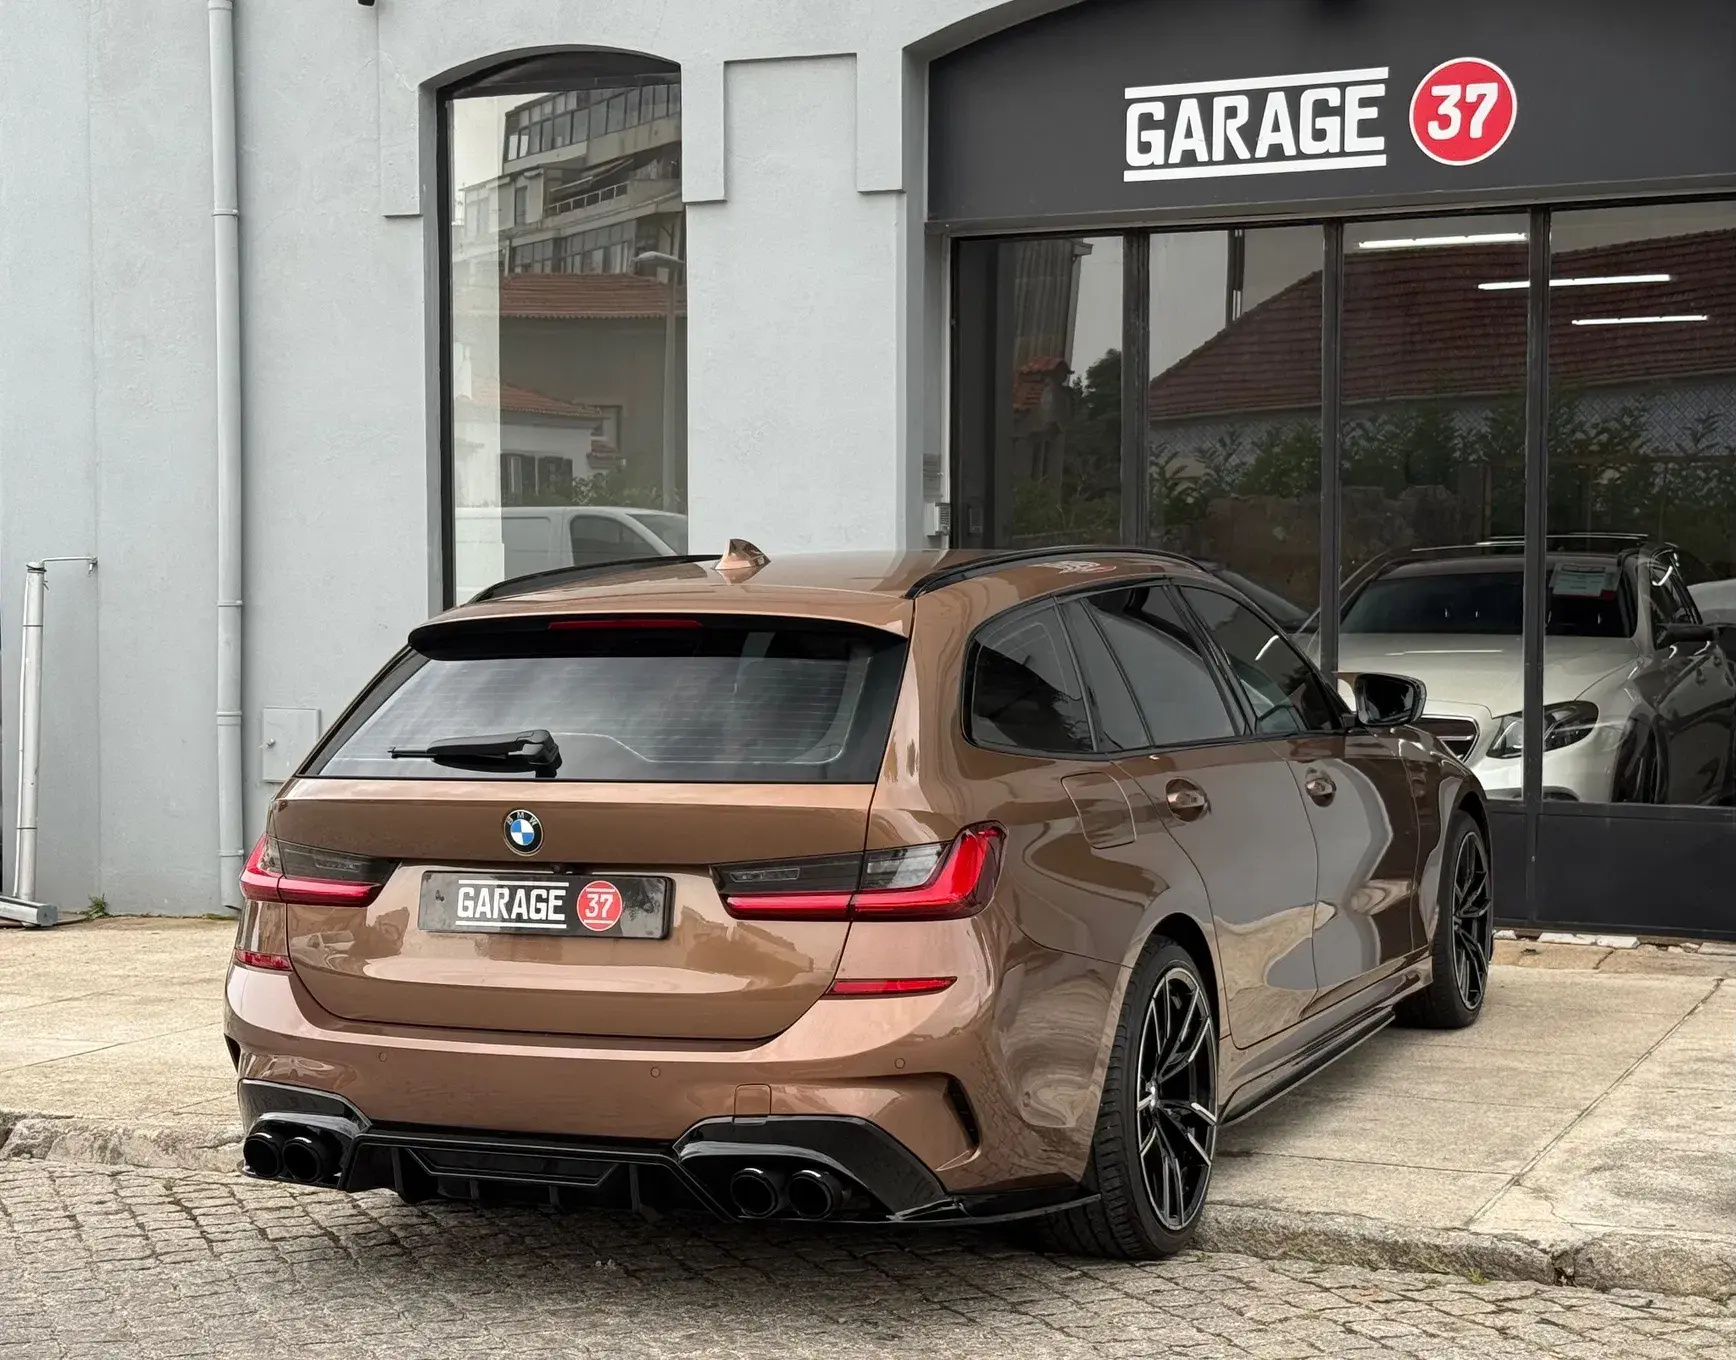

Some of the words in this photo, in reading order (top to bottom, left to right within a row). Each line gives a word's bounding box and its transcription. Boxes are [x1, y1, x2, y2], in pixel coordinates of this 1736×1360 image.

[1126, 83, 1386, 167] GARAGE
[1427, 82, 1499, 140] 37
[506, 811, 538, 826] BMW
[457, 887, 566, 921] GARAGE
[584, 893, 614, 918] 37
